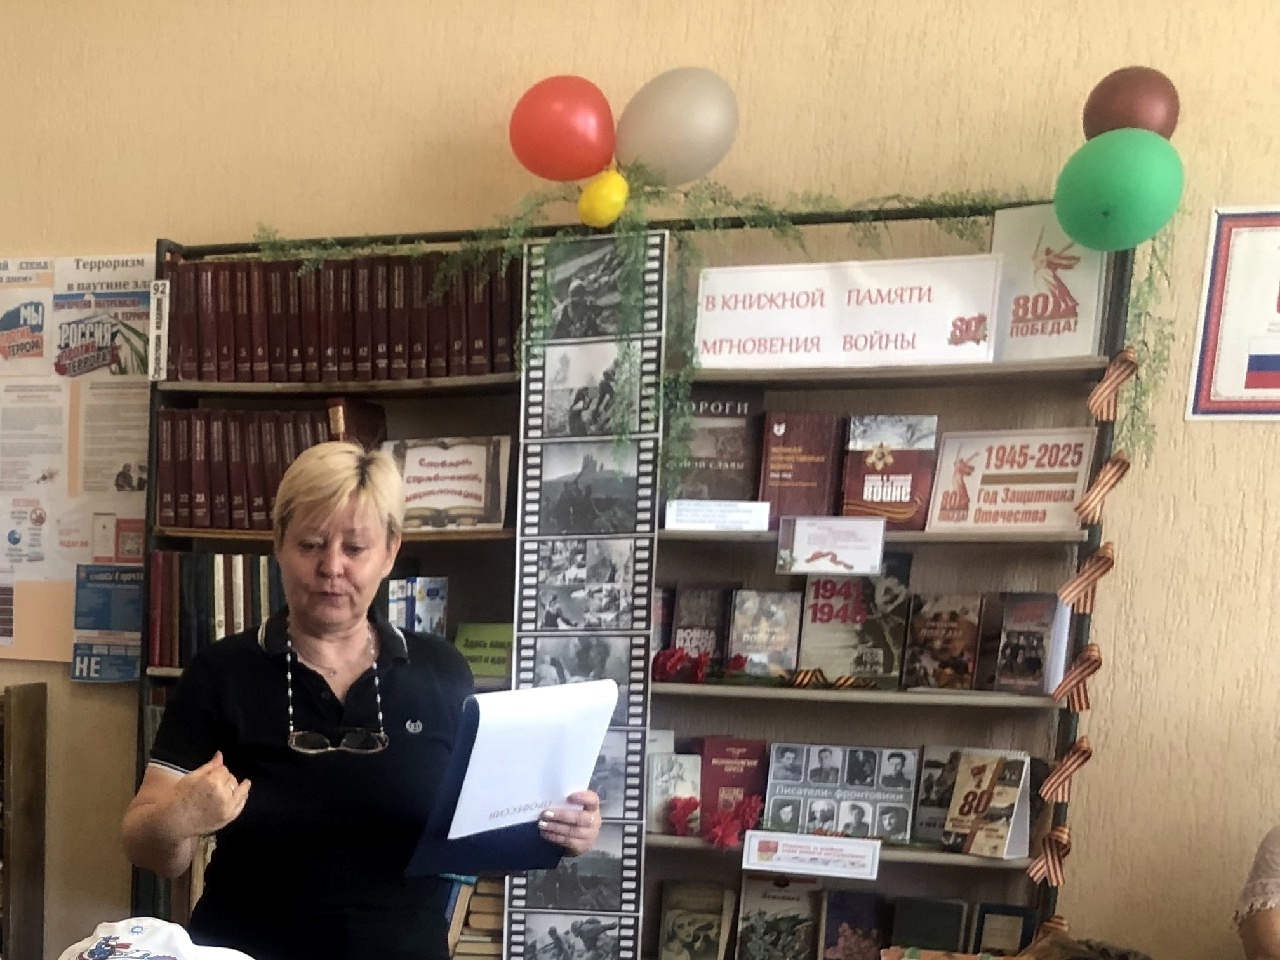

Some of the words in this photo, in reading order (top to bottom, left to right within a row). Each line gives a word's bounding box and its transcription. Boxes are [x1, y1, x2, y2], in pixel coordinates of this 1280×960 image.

[74, 258, 145, 272] Терроризм
[77, 280, 130, 291] паутине
[152, 282, 167, 295] 92
[705, 296, 716, 312] В
[721, 288, 825, 310] КНИЖНОЙ
[846, 285, 933, 307] ПАМЯТИ
[1012, 293, 1049, 322] 80
[20, 305, 43, 325] МЫ
[61, 323, 111, 348] РОССИЯ
[1010, 320, 1078, 338] ПОБЕДА!
[700, 335, 822, 356] МГНОВЕНИЯ
[842, 331, 917, 352] ВОЙНЫ
[985, 443, 1084, 470] 1945-2025
[977, 488, 997, 505] Год
[1002, 487, 1075, 505] Защитника
[973, 509, 1046, 524] Отечества
[811, 579, 864, 600] 1941
[75, 656, 101, 677] НЕ
[834, 787, 904, 801] фронтовики
[958, 789, 994, 817] 80
